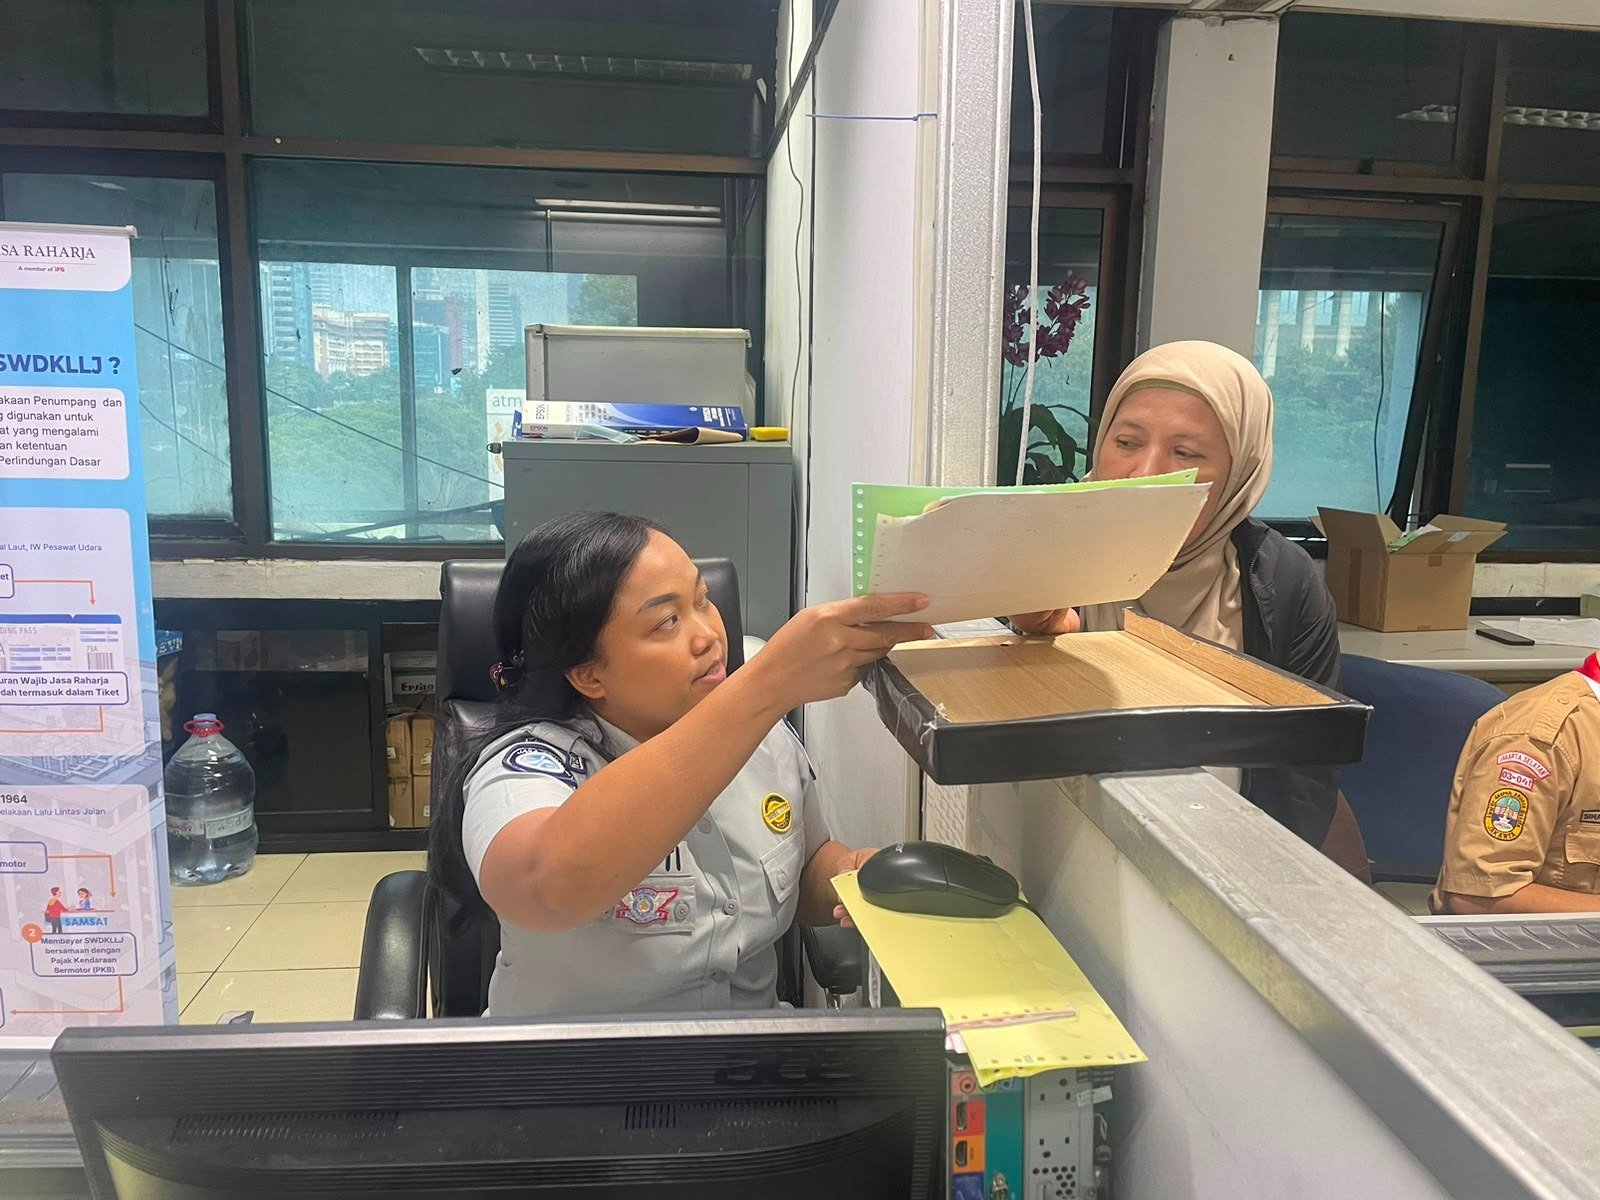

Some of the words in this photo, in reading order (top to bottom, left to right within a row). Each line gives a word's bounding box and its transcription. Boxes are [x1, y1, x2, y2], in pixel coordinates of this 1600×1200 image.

[0, 245, 19, 256] SA
[23, 245, 96, 260] RAHARJA
[108, 357, 121, 375] ?
[34, 395, 97, 409] Penumpang
[102, 398, 122, 407] dan
[492, 394, 522, 407] atm
[6, 411, 61, 422] digunakan
[64, 412, 94, 421] untuk
[12, 428, 39, 437] yang
[42, 427, 99, 438] mengalami
[16, 441, 67, 451] ketentuan
[70, 457, 101, 467] Dasar
[8, 543, 28, 552] Laut,
[43, 543, 77, 551] Pesawat
[19, 627, 37, 635] PASS
[20, 677, 48, 686] Wajib
[50, 676, 72, 684] Jasa
[74, 676, 109, 686] Raharja
[19, 688, 64, 697] termasuk
[65, 688, 94, 697] dalam
[96, 688, 120, 697] Tiket
[1522, 756, 1546, 776] SELATAN
[0, 794, 28, 804] 1964
[34, 808, 52, 816] Lalu
[54, 808, 81, 816] Lintas
[64, 917, 109, 926] SAMSAT
[28, 928, 37, 937] 2
[40, 937, 83, 946] Membayar
[91, 947, 121, 955] dengan
[51, 957, 72, 965] Pajak
[92, 966, 115, 974] (PKB)
